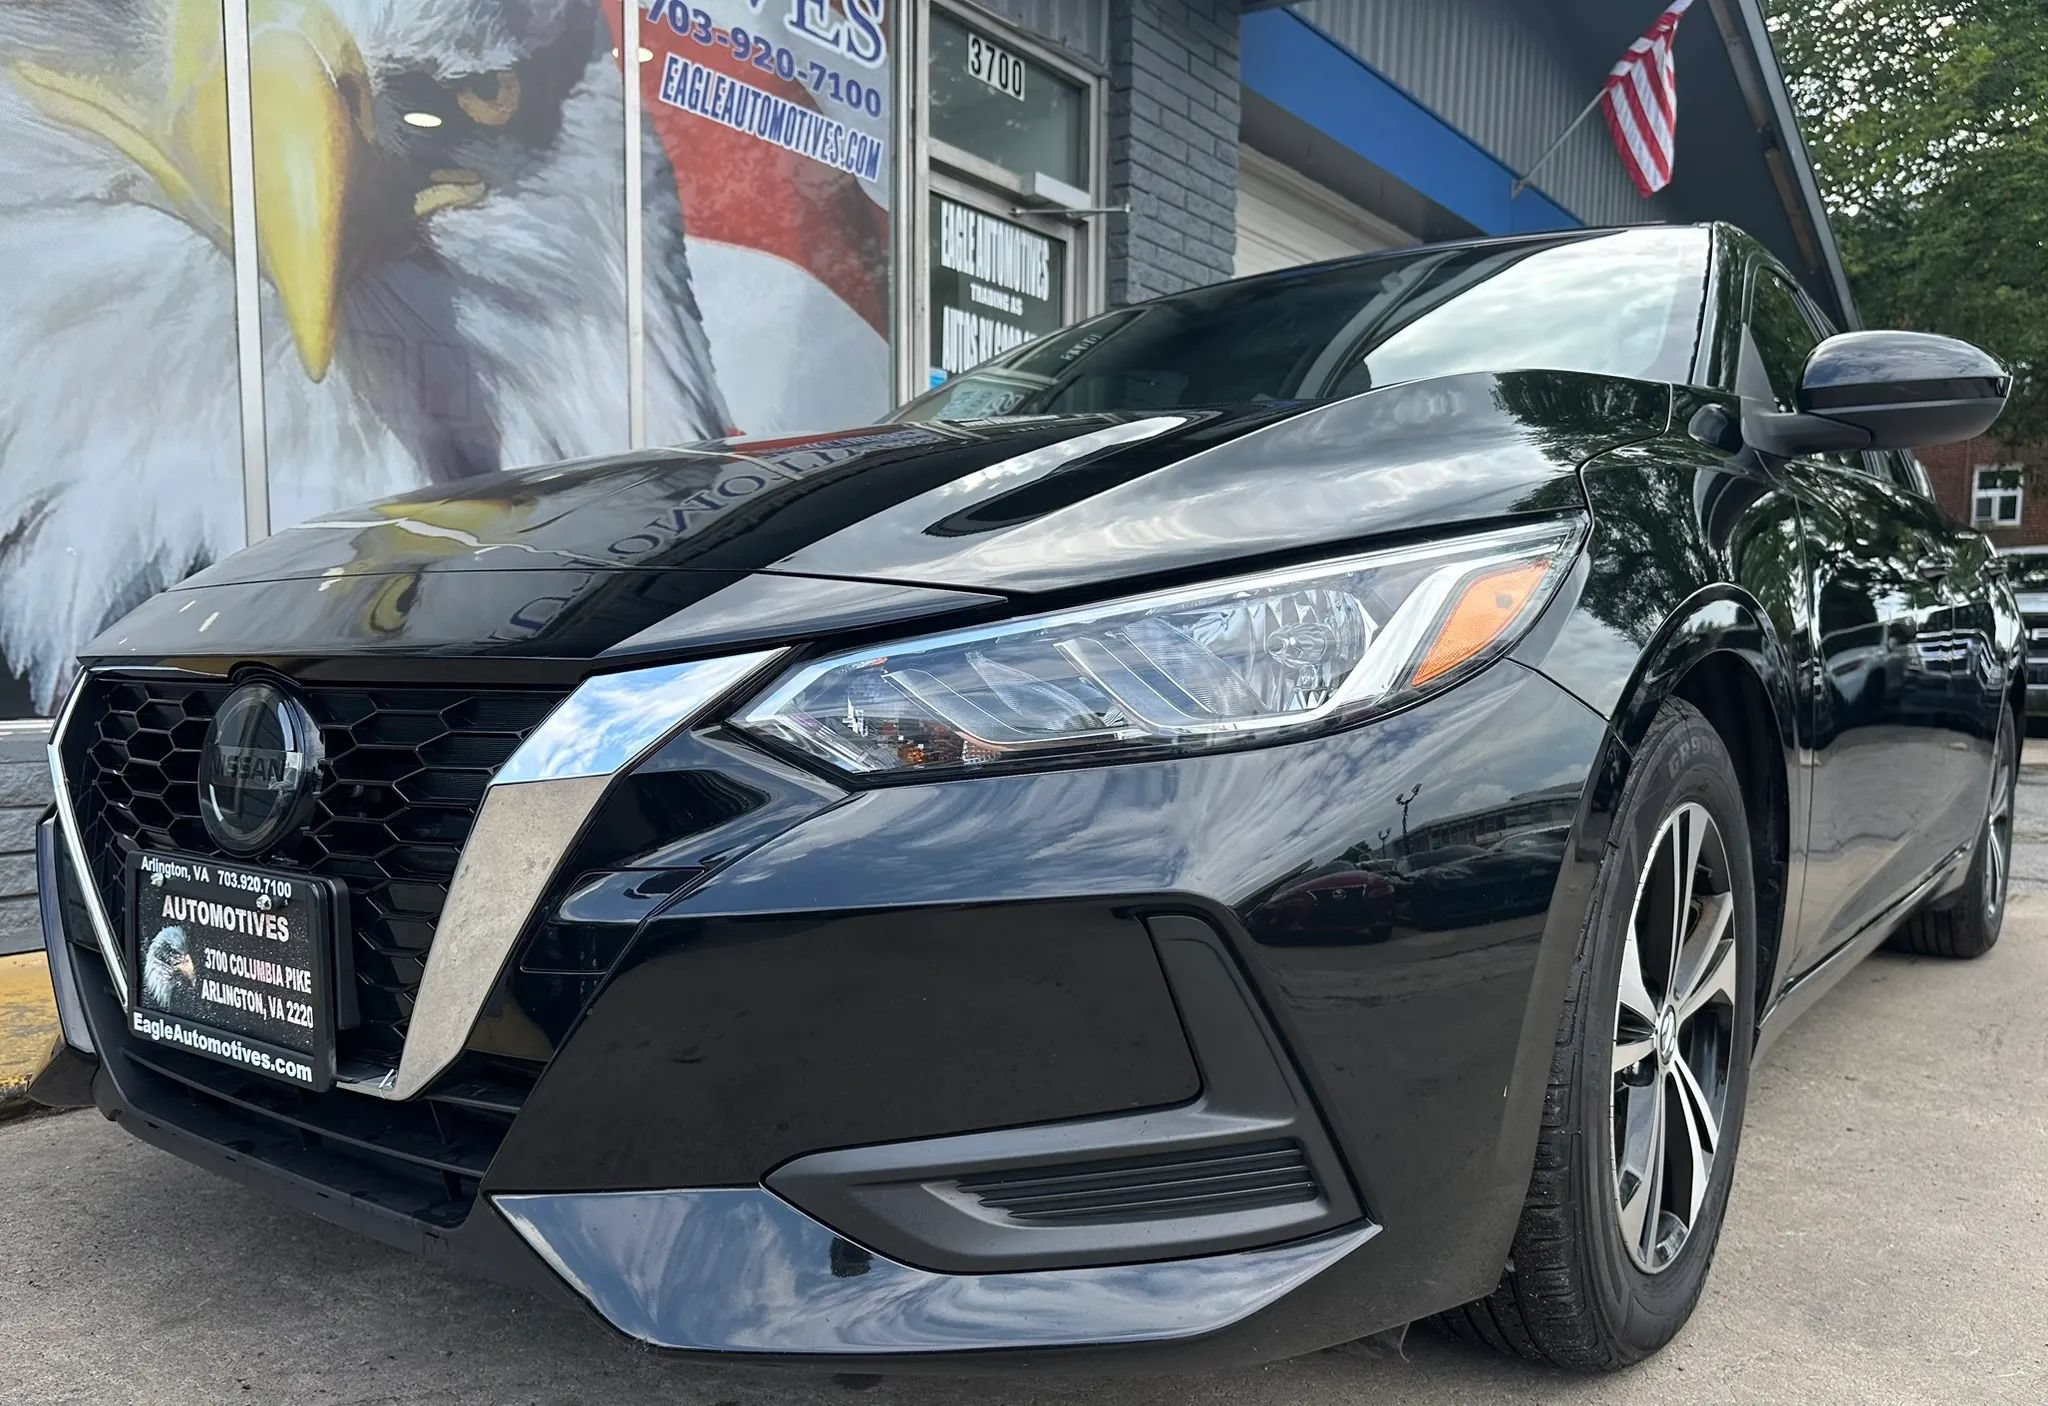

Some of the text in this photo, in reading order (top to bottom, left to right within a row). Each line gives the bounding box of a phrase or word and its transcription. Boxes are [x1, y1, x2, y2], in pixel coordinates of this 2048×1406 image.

[647, 0, 883, 119] 703-920-7100
[971, 37, 1022, 97] 3700
[660, 54, 883, 182] EAGLEAUTOMOTIVES.COM
[1010, 295, 1023, 317] AS
[209, 752, 287, 783] NISSAN
[140, 855, 292, 899] Arlington, VA 703.920.7100
[161, 894, 290, 943] AUTOMOTIVES
[204, 947, 312, 994] 3700 COLUMBIA PIKE
[201, 978, 267, 1021] ARLINGTON,
[268, 995, 285, 1021] VA
[133, 1011, 313, 1083] EagleAutomotives.com
